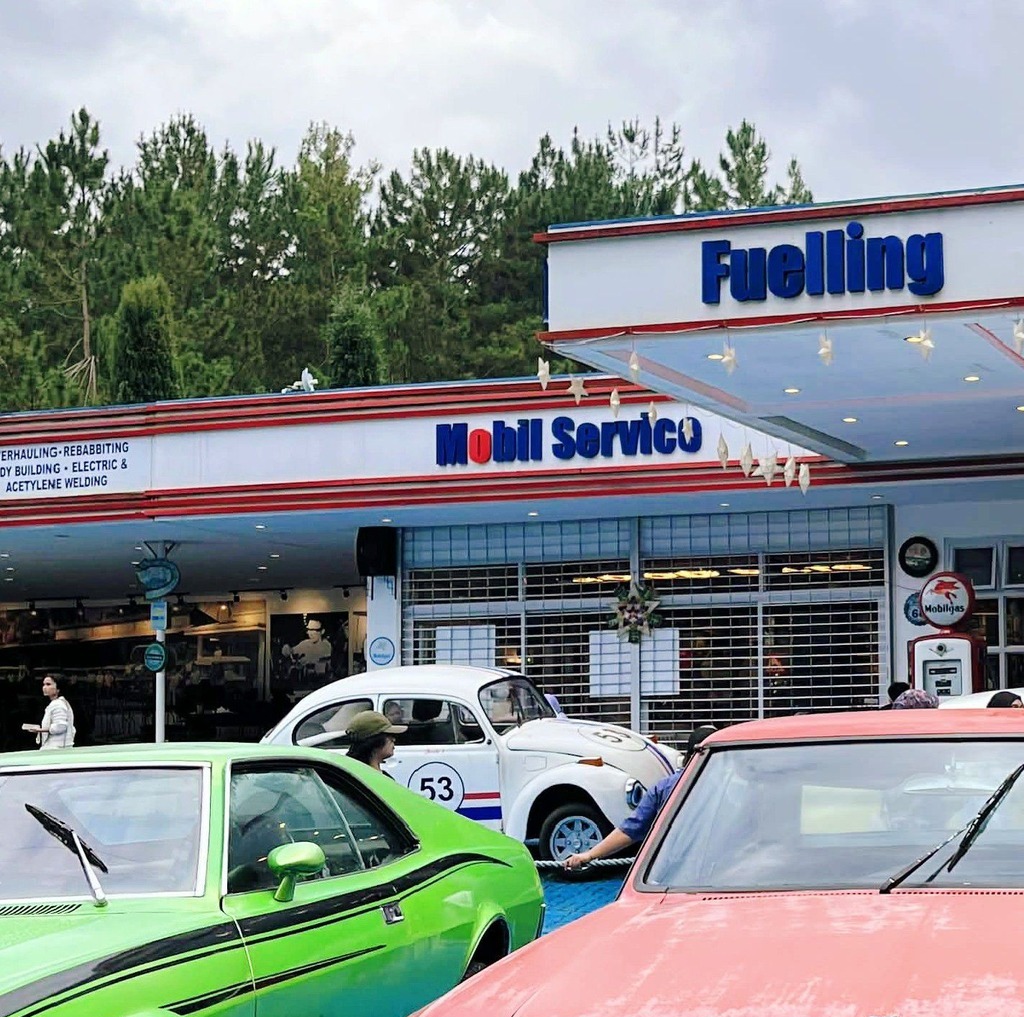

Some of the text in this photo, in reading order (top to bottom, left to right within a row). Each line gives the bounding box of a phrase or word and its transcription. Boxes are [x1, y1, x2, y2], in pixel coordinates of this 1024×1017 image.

[701, 221, 945, 304] Fuelling
[0, 441, 129, 461] ERHAULING REBABBITING
[435, 418, 543, 466] Mobil
[15, 463, 61, 476] BUILDING
[72, 459, 118, 472] ELECTRIC
[121, 458, 128, 469] &
[6, 475, 108, 492] ACETYLENE WELDING
[924, 604, 965, 615] Mobilgas
[420, 776, 454, 801] 53
